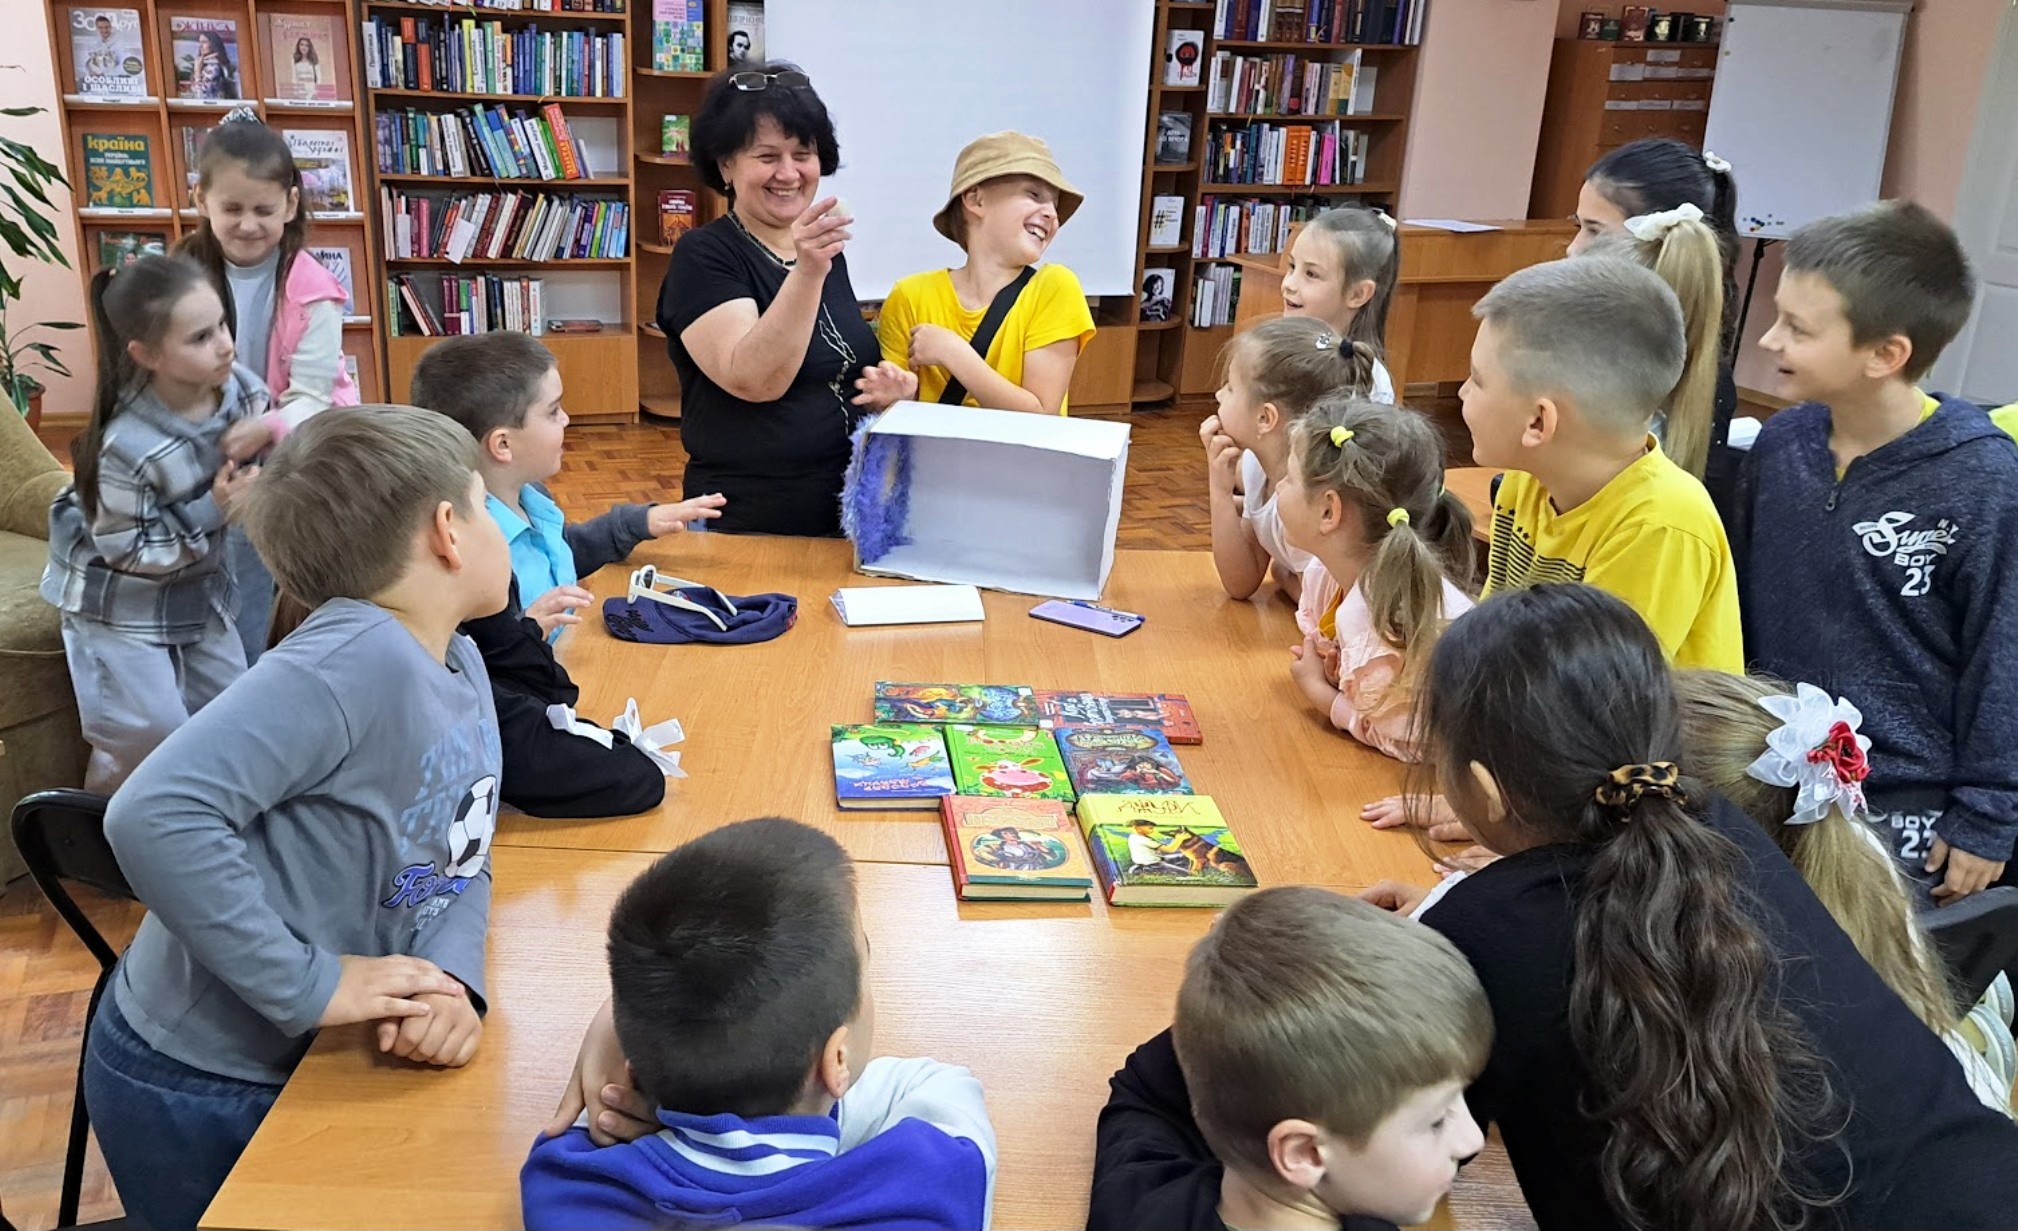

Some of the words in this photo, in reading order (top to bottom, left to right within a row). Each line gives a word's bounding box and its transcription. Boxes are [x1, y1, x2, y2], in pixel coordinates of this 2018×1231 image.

[367, 33, 376, 68] Політика
[1894, 553, 1937, 567] BOY
[1891, 815, 1936, 829] BOY
